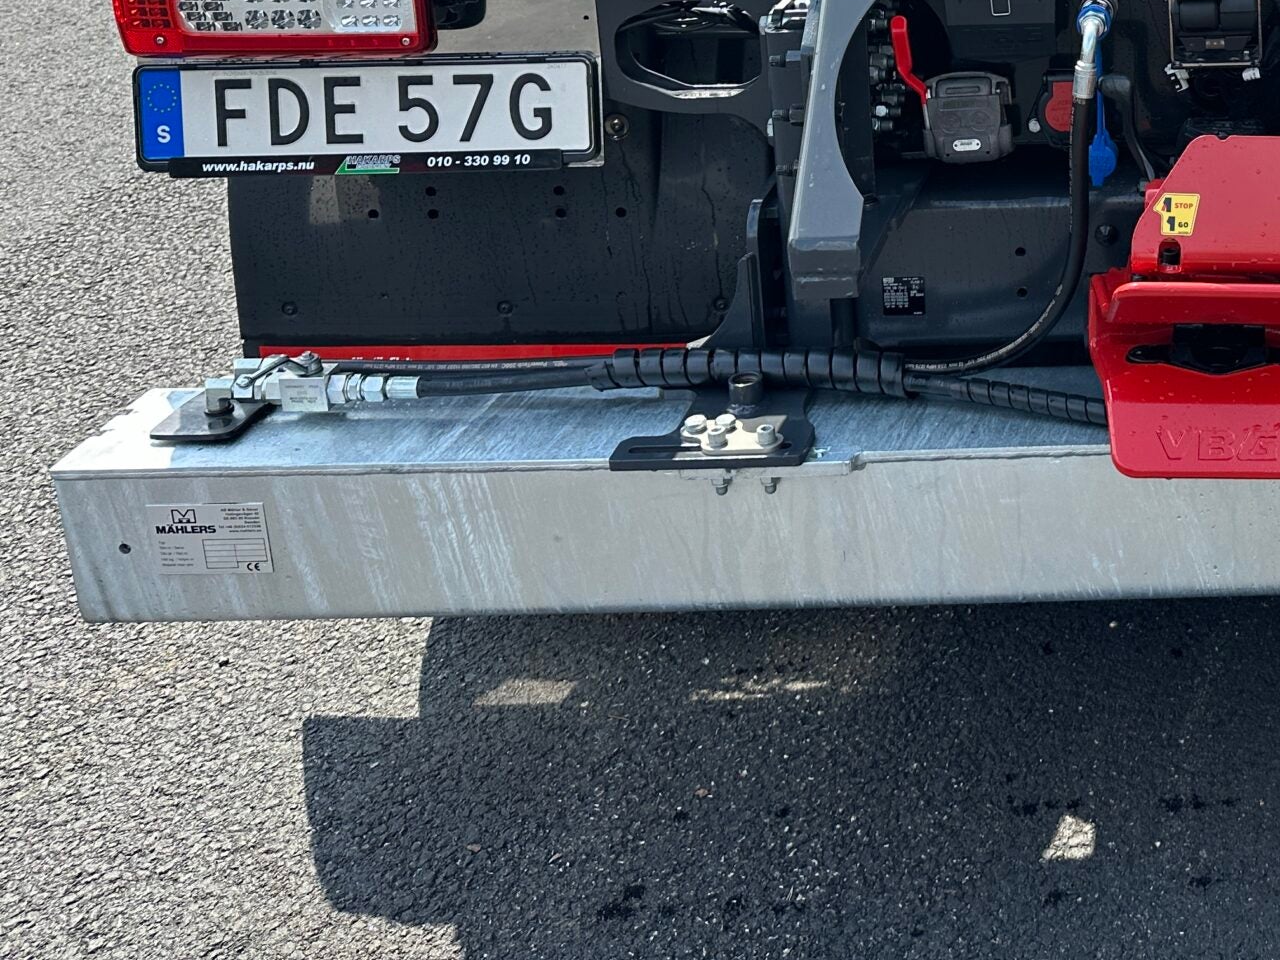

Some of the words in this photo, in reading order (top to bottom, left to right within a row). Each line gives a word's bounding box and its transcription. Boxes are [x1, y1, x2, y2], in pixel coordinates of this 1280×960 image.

[214, 76, 364, 147] FDE
[397, 72, 553, 143] 57G
[157, 125, 171, 144] S
[202, 158, 315, 173] www.hakarps.nu
[347, 154, 401, 165] HAKARPS
[427, 156, 453, 167] 010
[464, 155, 490, 166] 330
[493, 155, 511, 165] 99
[513, 154, 531, 165] 10
[1156, 428, 1278, 461] VBG
[155, 524, 217, 535] MÄHLERS
